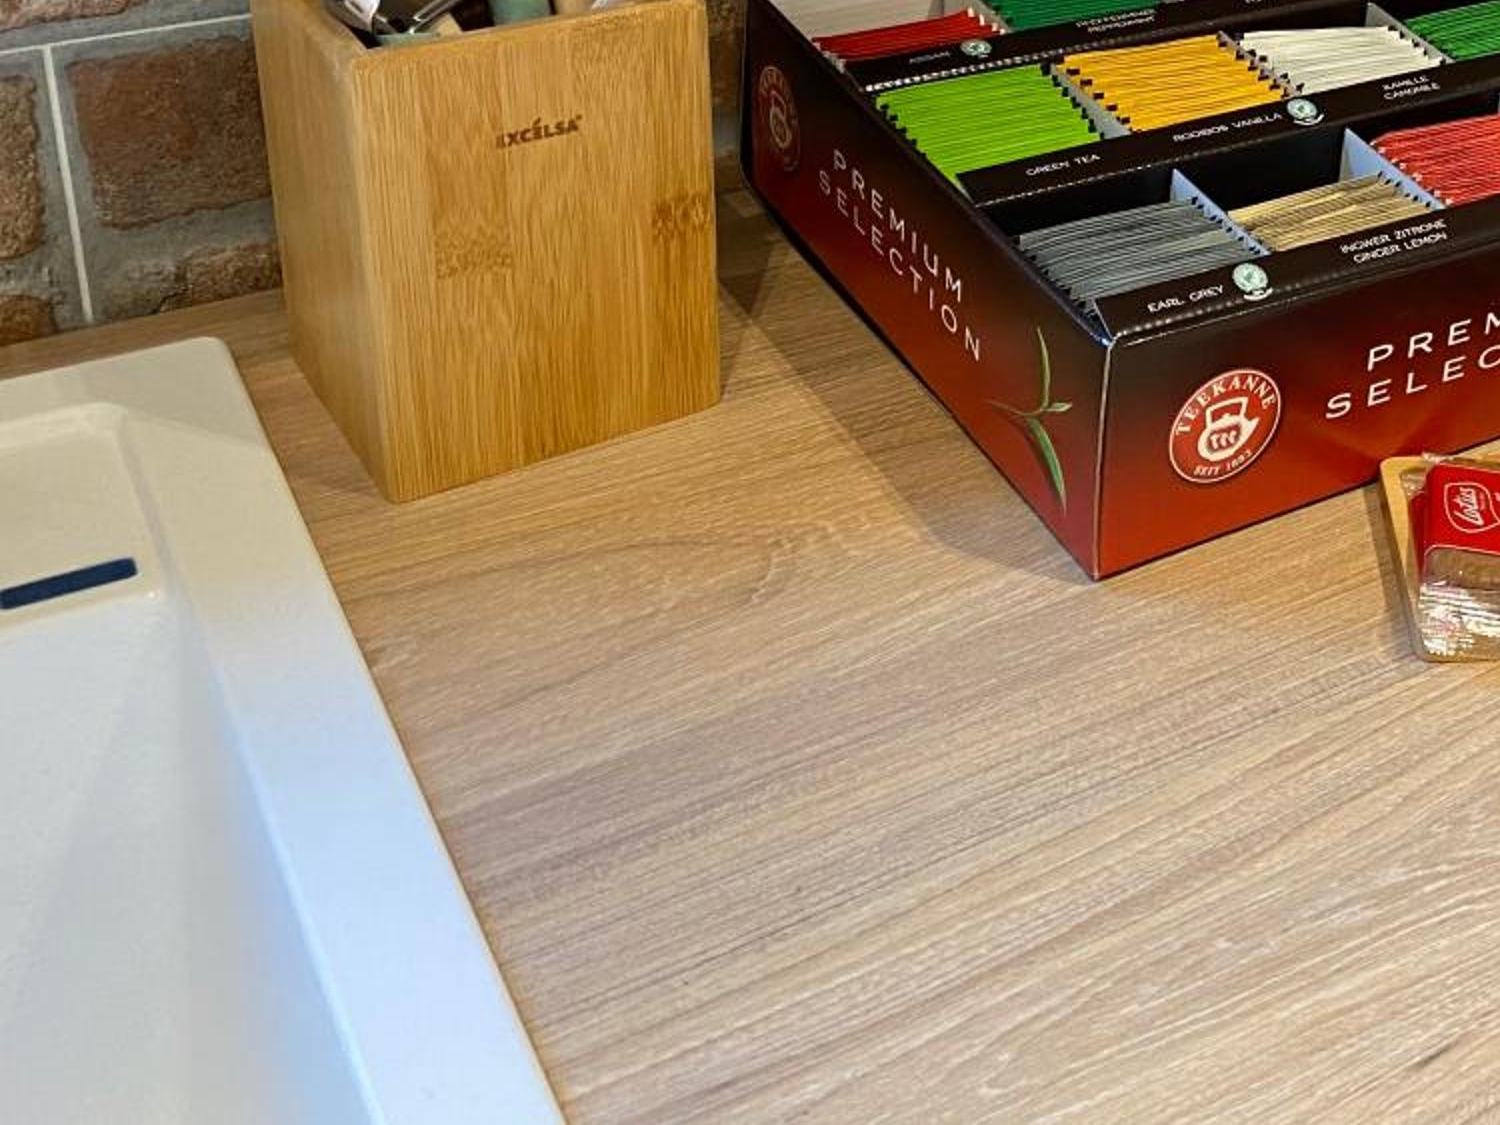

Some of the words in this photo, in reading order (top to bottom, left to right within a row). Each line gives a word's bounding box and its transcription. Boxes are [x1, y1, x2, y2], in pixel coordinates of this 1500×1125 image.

[1231, 112, 1283, 130] VANILLA
[1025, 160, 1070, 177] GREEN
[1073, 153, 1101, 168] TEA
[833, 149, 961, 303] PREMIUM
[1339, 233, 1390, 254] INGWER
[1352, 245, 1401, 264] GINGER
[1404, 231, 1448, 251] LEMON
[818, 169, 982, 362] SELECTION
[1147, 295, 1185, 314] EARL
[1188, 284, 1225, 301] GREY
[1175, 375, 1277, 436] TEEKANNE
[1453, 477, 1485, 527] Lotus
